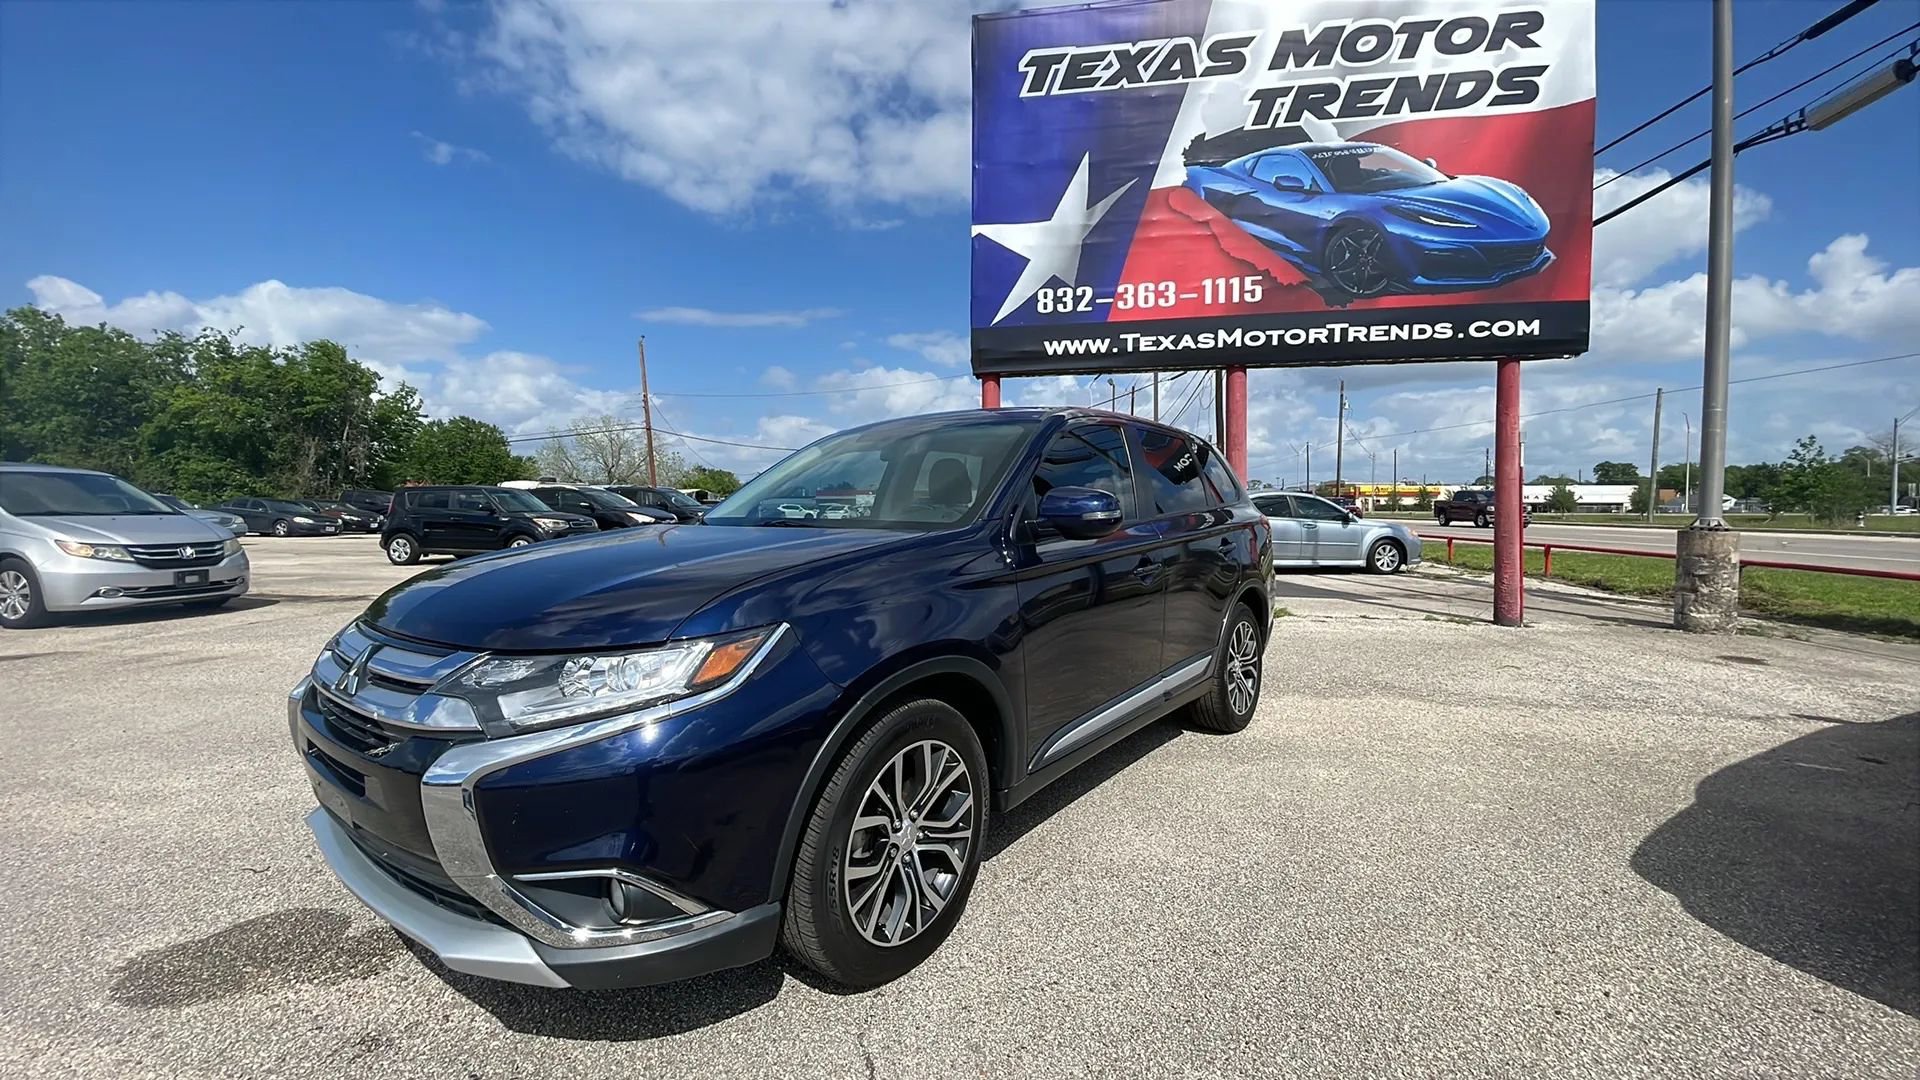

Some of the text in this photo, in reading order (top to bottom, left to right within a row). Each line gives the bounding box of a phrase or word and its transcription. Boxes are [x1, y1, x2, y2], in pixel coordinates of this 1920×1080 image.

[1020, 11, 1545, 95] TEXAS MOTOR
[1250, 65, 1549, 127] TRENDS
[1036, 275, 1263, 313] 832-363-1115
